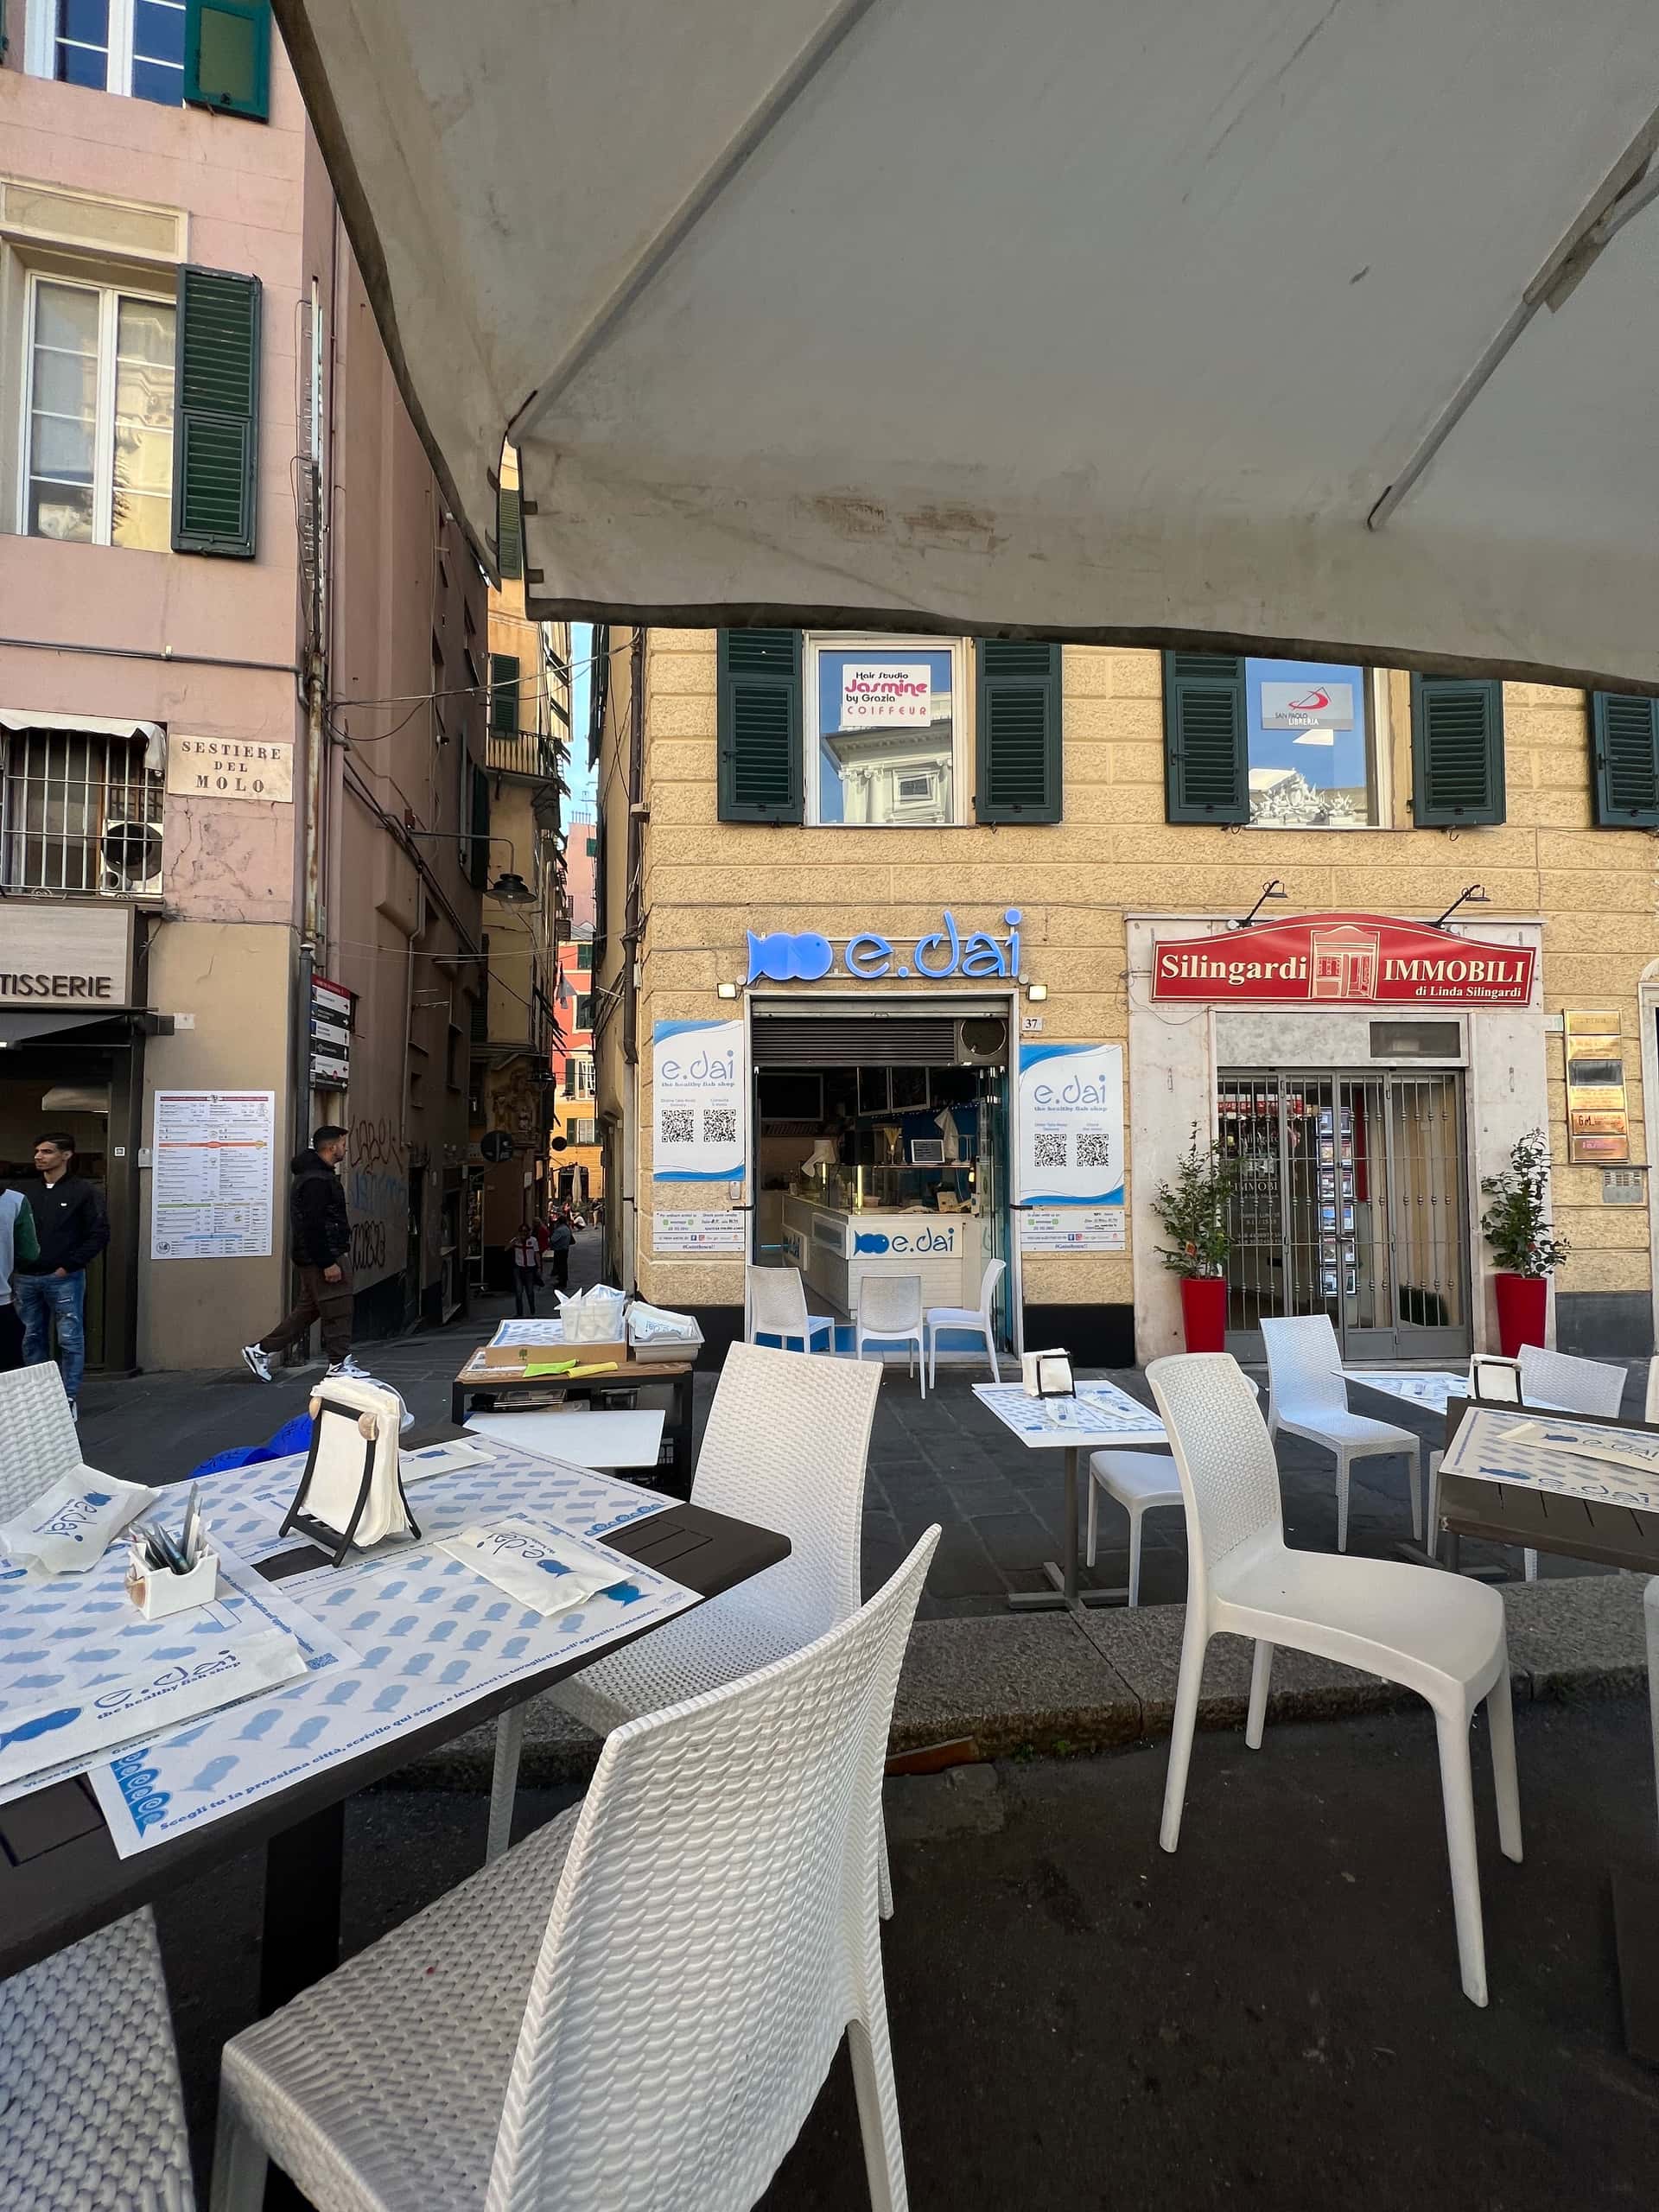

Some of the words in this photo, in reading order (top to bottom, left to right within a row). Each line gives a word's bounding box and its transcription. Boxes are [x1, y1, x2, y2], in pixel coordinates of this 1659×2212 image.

[855, 671, 876, 681] Hair
[844, 678, 928, 697] Jasmine
[846, 693, 859, 704] by
[861, 694, 896, 702] Grazia
[847, 706, 927, 715] COIFFEUR
[181, 741, 281, 760] SESTIERE
[213, 760, 248, 772] DEL
[195, 774, 265, 793] MOLO
[844, 908, 1022, 979] e.dai
[1160, 954, 1307, 986] Silingardi
[1382, 959, 1526, 983] IMMOBILI
[0, 974, 111, 998] TISSERIE
[1415, 986, 1427, 996] di
[1430, 986, 1464, 997] Linda
[1465, 986, 1522, 1000] Silingardi
[1025, 1018, 1038, 1029] 37
[662, 1050, 734, 1080] e.dai
[1034, 1075, 1106, 1104] e.dai
[892, 1227, 954, 1253] e.dai
[97, 1707, 122, 1719] the
[124, 1684, 179, 1709] healthy
[181, 1674, 207, 1686] fish
[209, 1662, 241, 1675] shop
[160, 1806, 208, 1831] Scegli
[210, 1798, 227, 1808] tu
[228, 1791, 244, 1801] la
[245, 1762, 310, 1795] prossima
[312, 1747, 346, 1764] città,
[346, 1725, 391, 1748] scrivilo
[393, 1714, 412, 1727] qui
[413, 1700, 445, 1717] sopra
[454, 1677, 499, 1699] inserisci
